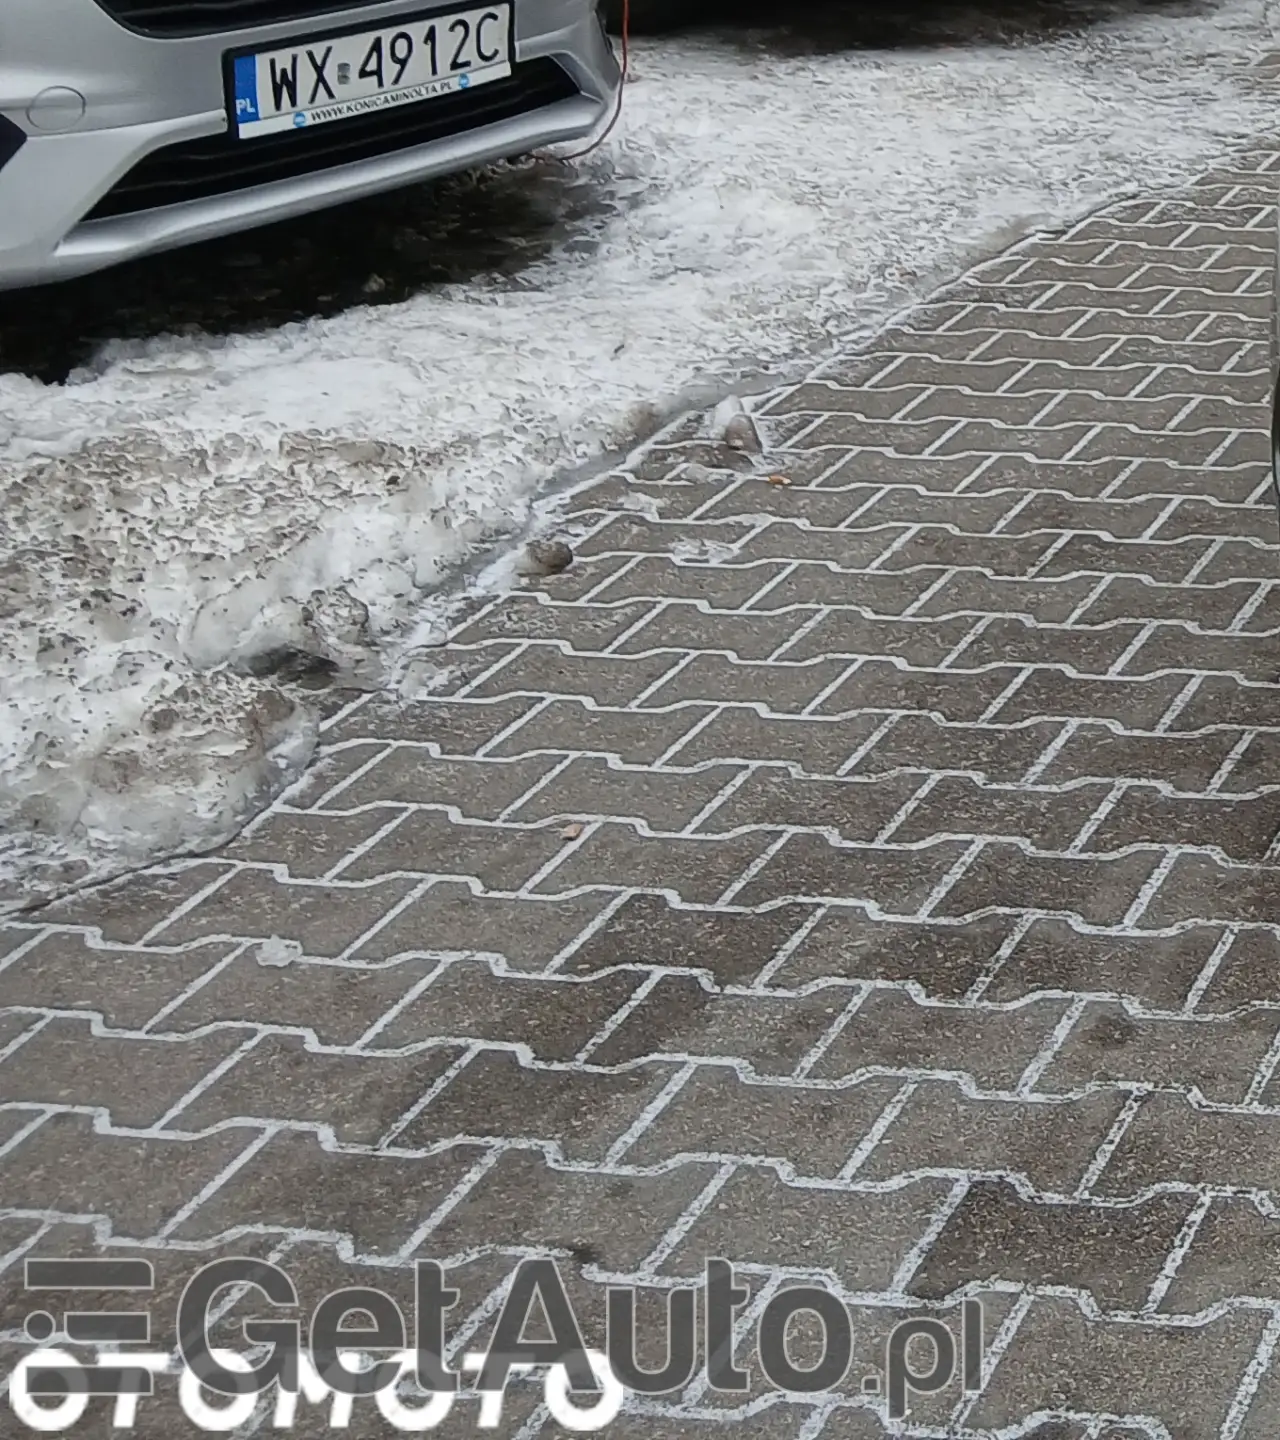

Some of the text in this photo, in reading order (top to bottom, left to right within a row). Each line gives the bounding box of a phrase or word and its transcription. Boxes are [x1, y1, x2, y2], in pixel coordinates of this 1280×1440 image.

[269, 11, 499, 112] WX 4912C
[236, 99, 256, 114] PL
